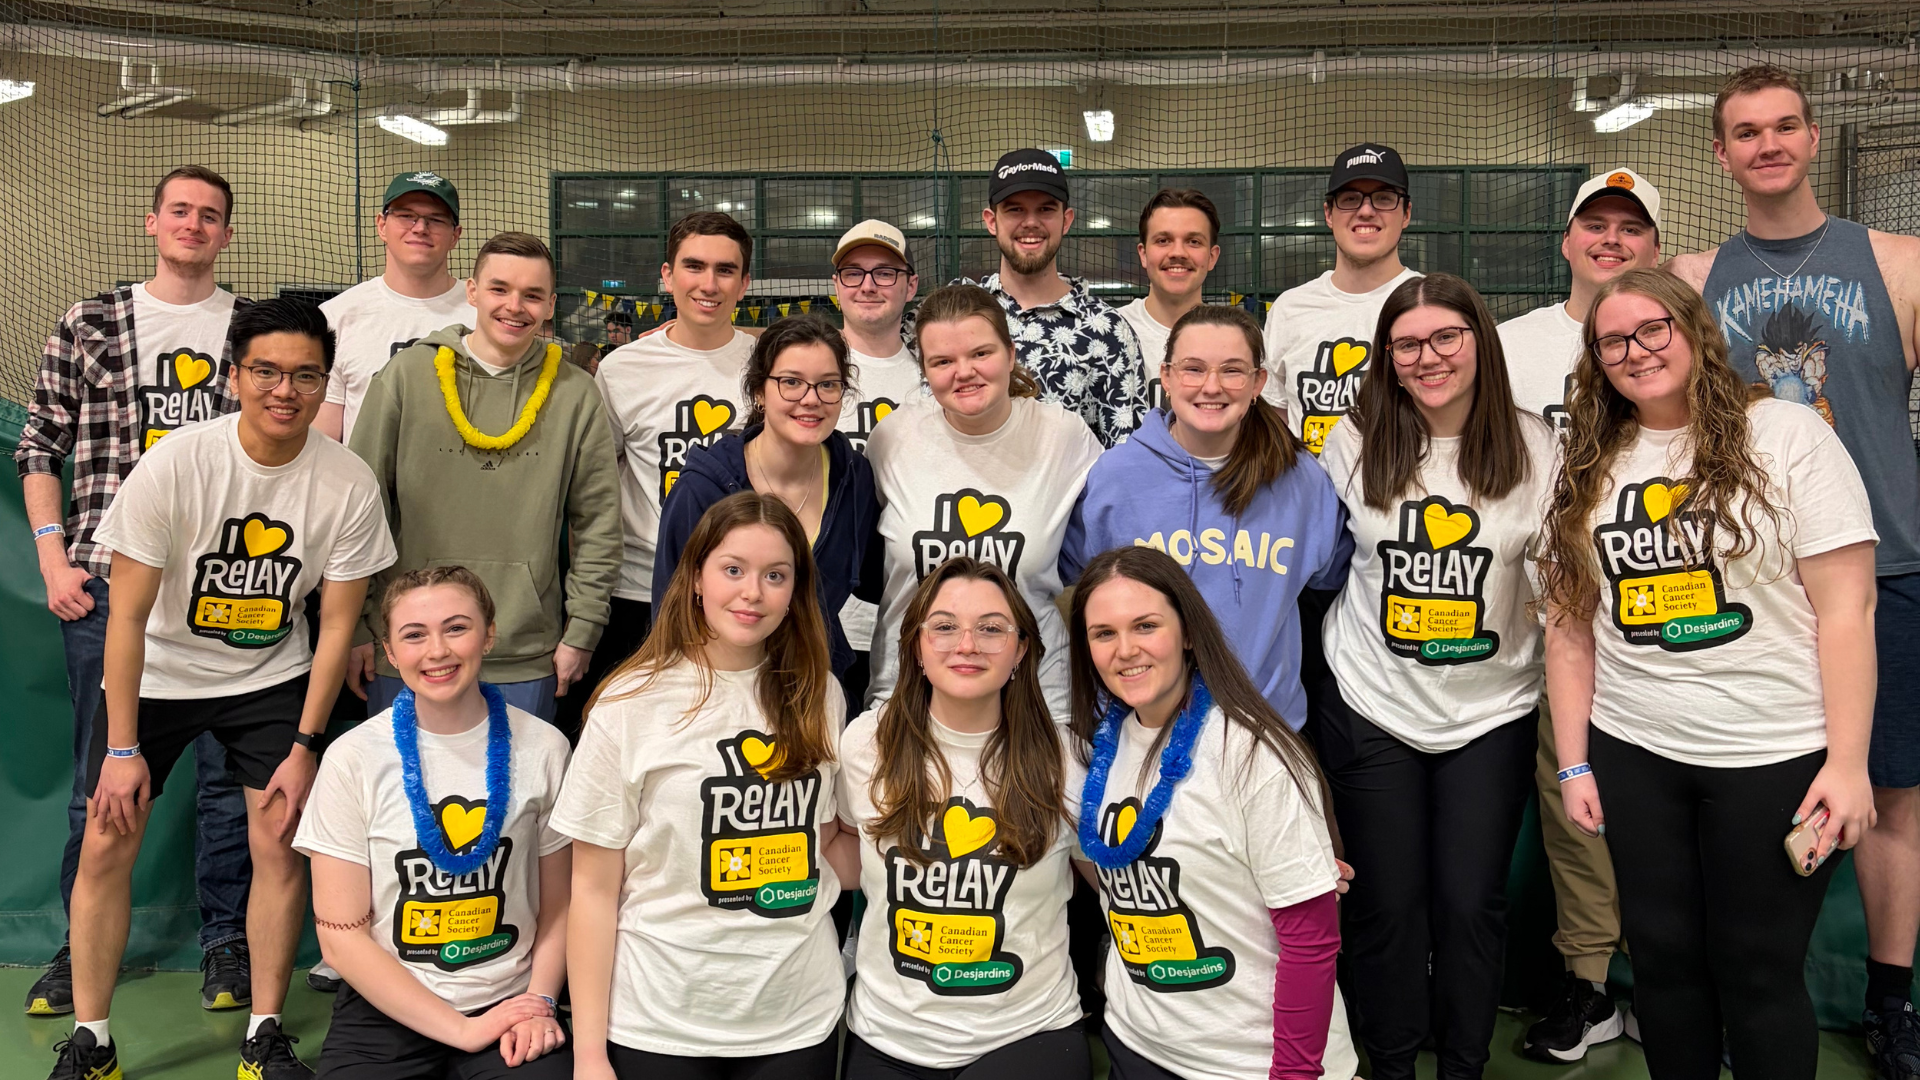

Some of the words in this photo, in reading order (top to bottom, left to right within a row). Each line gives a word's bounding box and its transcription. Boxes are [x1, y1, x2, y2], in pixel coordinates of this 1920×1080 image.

[1346, 155, 1377, 168] PUMA
[998, 163, 1058, 179] TaylorMade
[1717, 274, 1870, 347] KAMEHAMEHA
[1320, 348, 1330, 373] I
[163, 360, 170, 386] I
[682, 406, 689, 432] I
[864, 408, 870, 432] I
[1624, 490, 1636, 522] I
[942, 501, 951, 532] I
[1406, 508, 1417, 542] I
[226, 525, 239, 554] I
[1662, 581, 1706, 593] Canadian
[1662, 593, 1695, 602] Cancer
[1428, 608, 1470, 616] Canadian
[1664, 602, 1698, 612] Society
[1428, 617, 1458, 625] Cancer
[1684, 616, 1740, 635] Desjardins
[1428, 625, 1458, 633] Society
[1441, 643, 1490, 654] Desjardins
[726, 746, 744, 776] I
[758, 845, 802, 856] Canadian
[758, 856, 790, 865] Cancer
[758, 866, 792, 875] Society
[718, 895, 745, 904] presented
[746, 894, 752, 902] by
[777, 885, 817, 900] Desjardin
[449, 907, 491, 916] Canadian
[447, 925, 480, 934] Society
[941, 926, 987, 937] Canadian
[1141, 926, 1182, 935] Canadian
[940, 936, 974, 946] Cancer
[1144, 936, 1173, 944] Cancer
[462, 938, 508, 956] Desjardins
[938, 946, 974, 956] Society
[1146, 945, 1176, 954] Society
[901, 960, 925, 972] presented
[925, 964, 931, 975] by
[954, 968, 1011, 980] Desjardins
[1167, 961, 1223, 978] Desjardins
